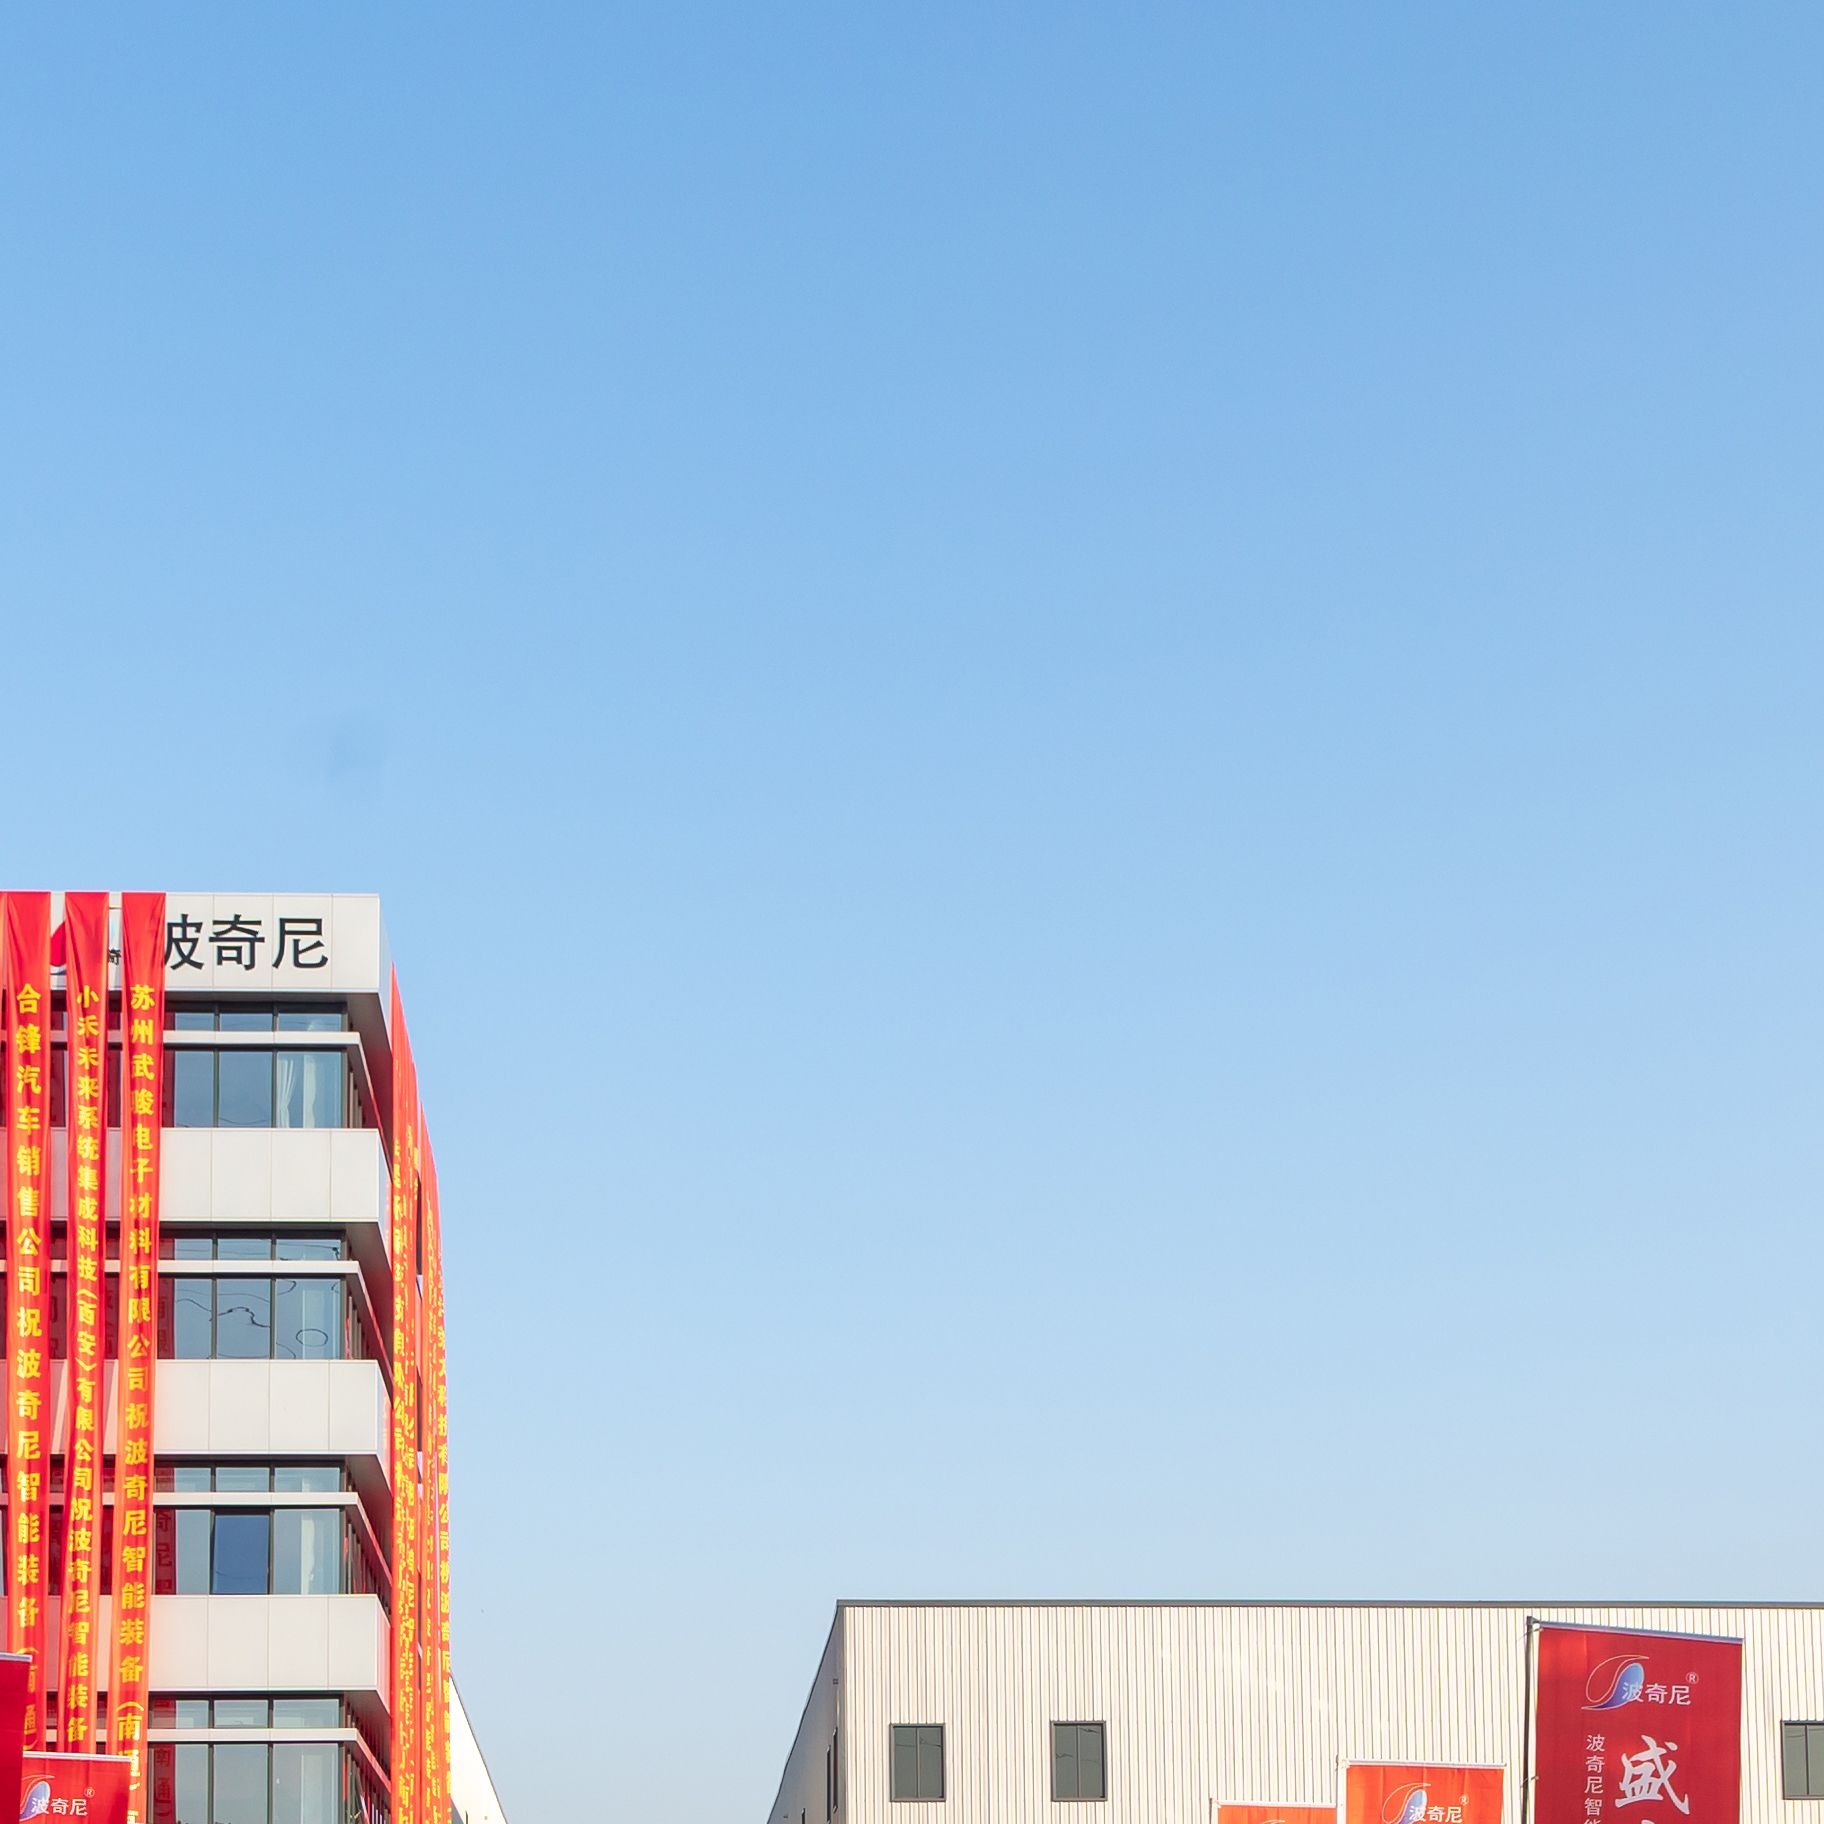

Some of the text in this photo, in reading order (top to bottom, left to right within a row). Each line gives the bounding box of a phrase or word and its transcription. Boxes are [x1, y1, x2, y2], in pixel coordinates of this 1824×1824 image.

[1622, 1681, 1692, 1705] 波奇尼
[31, 1798, 88, 1816] 波奇尼
[1408, 1804, 1463, 1824] 波奇尼
